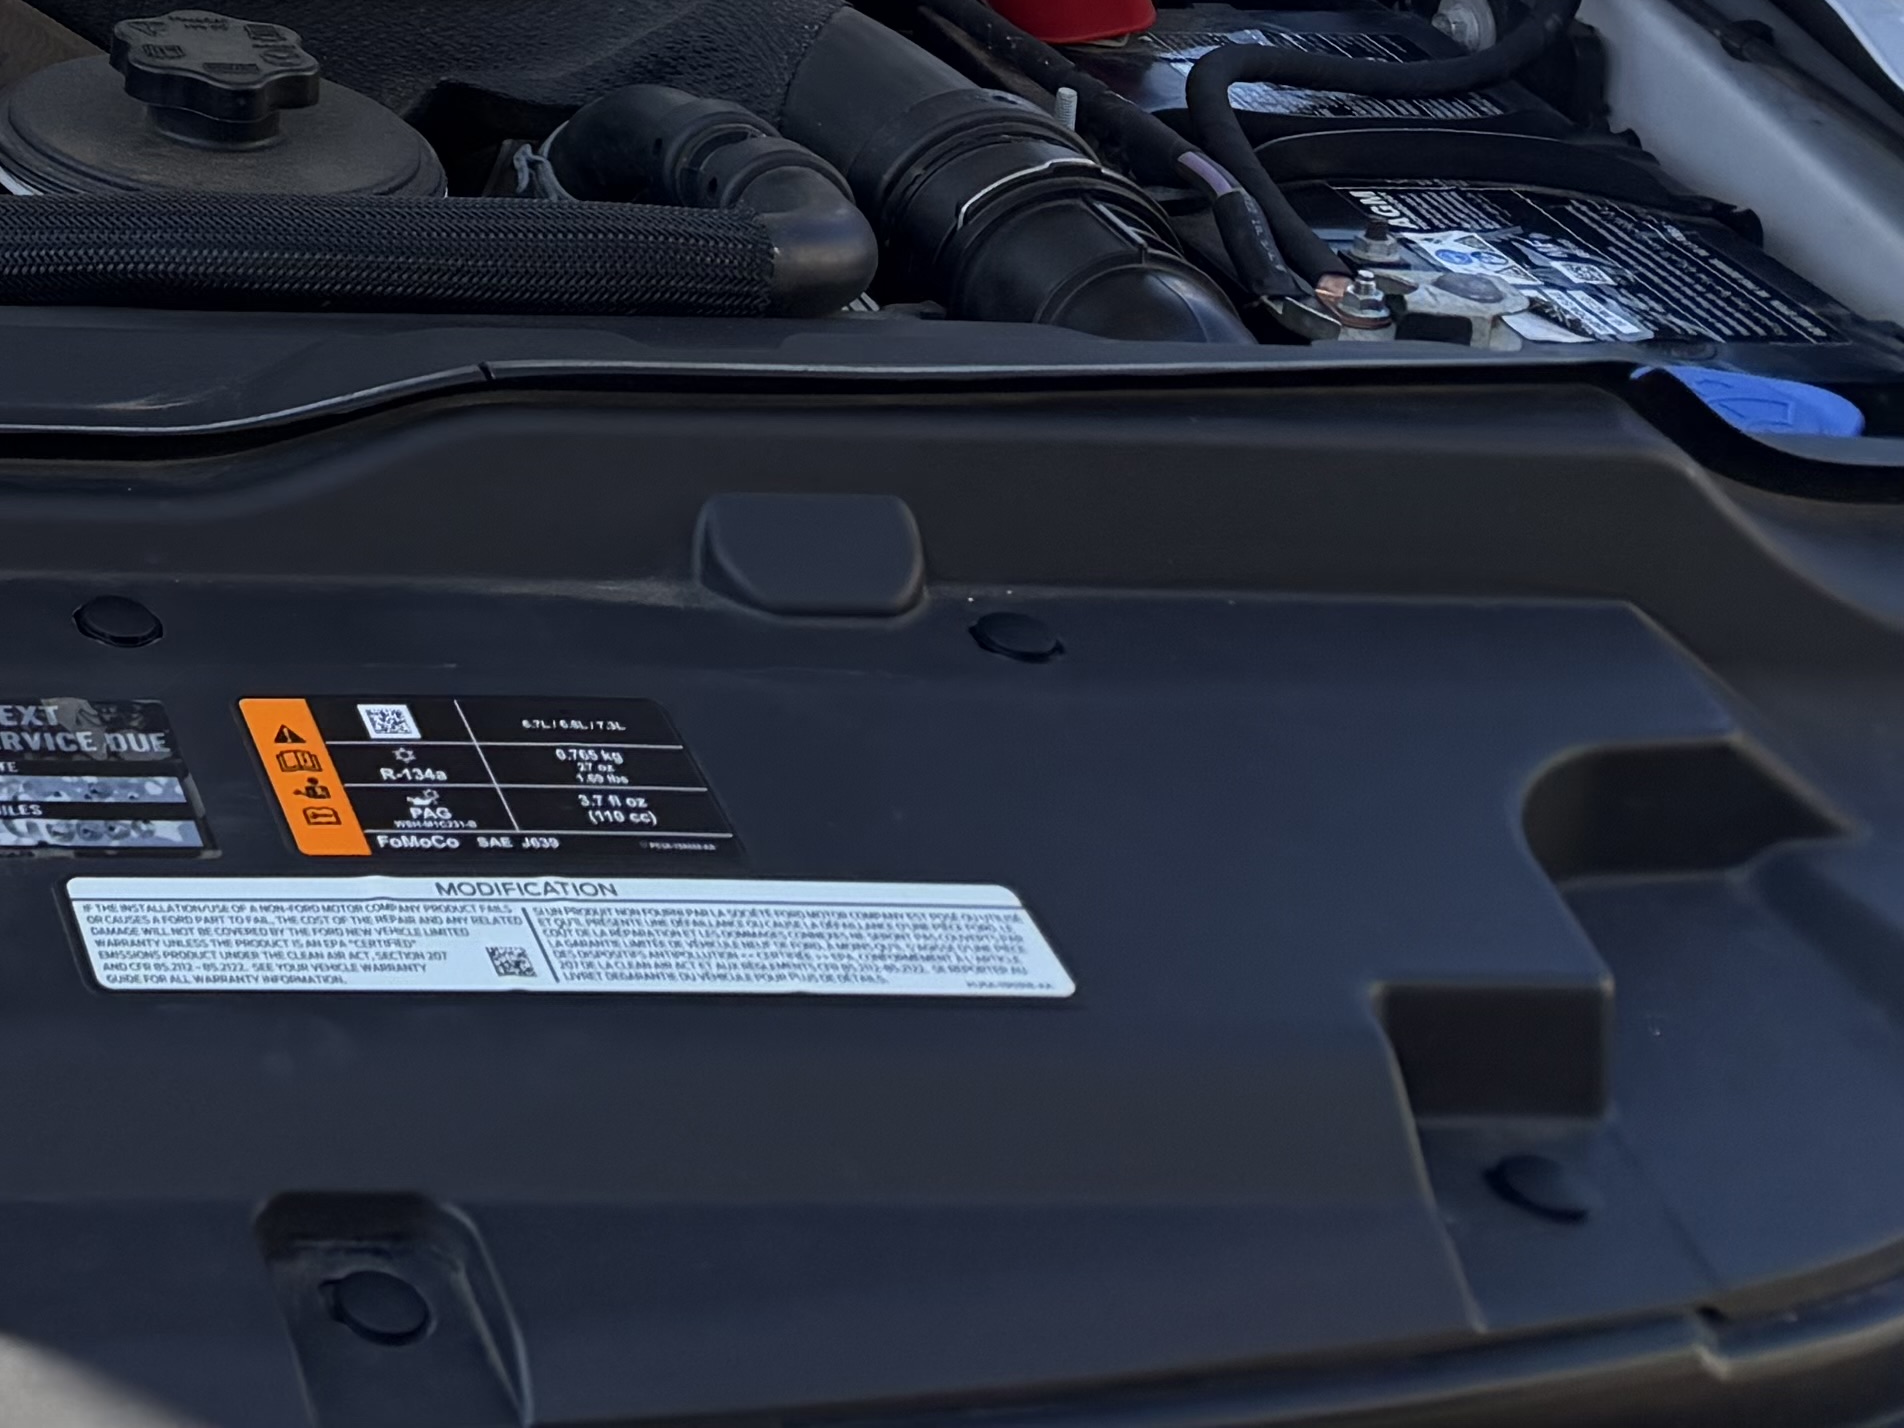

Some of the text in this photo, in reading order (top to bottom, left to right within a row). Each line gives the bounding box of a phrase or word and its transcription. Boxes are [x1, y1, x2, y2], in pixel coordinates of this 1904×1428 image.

[1350, 190, 1420, 230] AGM
[522, 719, 550, 729] 6.7L
[596, 721, 626, 731] 7.3L
[105, 732, 171, 753] DUE
[555, 749, 624, 764] 0.765 kg
[578, 763, 615, 772] 27 oz
[380, 768, 448, 781] R-134a
[607, 774, 629, 784] lbs
[578, 795, 648, 808] 3.7 fl oz
[410, 807, 452, 820] PAG
[588, 810, 657, 826] (110 cc)
[377, 836, 560, 849] FoMoCo SAE J639
[435, 881, 618, 897] MODIFICATION
[95, 904, 118, 913] THE
[120, 904, 229, 913] INSTALLATION/USE
[260, 904, 319, 913] NON-FORD
[322, 904, 363, 913] MOTOR
[365, 904, 420, 913] COMPANY
[424, 904, 477, 913] PRODUCT
[480, 904, 512, 913] FAILS
[105, 916, 150, 924] CAUSES
[162, 916, 193, 924] FORD
[195, 916, 226, 924] PART
[277, 916, 298, 924] THE
[300, 916, 330, 924] COST
[351, 916, 373, 924] THE
[376, 916, 417, 924] REPAIR
[419, 916, 443, 924] AND
[445, 916, 468, 924] ANY
[471, 916, 522, 924] RELATED
[91, 927, 139, 936] DAMAGE
[142, 927, 169, 936] WILL
[171, 927, 194, 936] NOT
[214, 927, 268, 936] COVERED
[290, 927, 311, 936] THE
[312, 927, 343, 936] FORD
[346, 927, 372, 936] NEW
[375, 927, 421, 936] VEHICLE
[423, 927, 469, 936] LIMITED
[95, 939, 161, 948] WARRANTY
[163, 939, 208, 948] UNLESS
[210, 939, 234, 948] THE
[235, 939, 289, 948] PRODUCT
[323, 939, 347, 948] EPA
[98, 951, 161, 960] EMISSIONS
[163, 951, 216, 960] PRODUCT
[219, 951, 259, 960] UNDER
[263, 951, 285, 960] THE
[287, 951, 324, 960] CLEAN
[327, 951, 346, 960] AIR
[375, 951, 426, 960] SECTION
[428, 951, 447, 960] 207
[103, 963, 127, 972] AND
[129, 963, 152, 972] CFR
[253, 963, 275, 972] SEE
[276, 963, 312, 972] YOUR
[313, 963, 359, 972] VEHICLE
[362, 963, 426, 972] WARRANTY
[106, 975, 141, 984] GUIDE
[144, 975, 168, 984] FOR
[170, 975, 191, 984] ALL
[193, 975, 259, 984] WARRANTY
